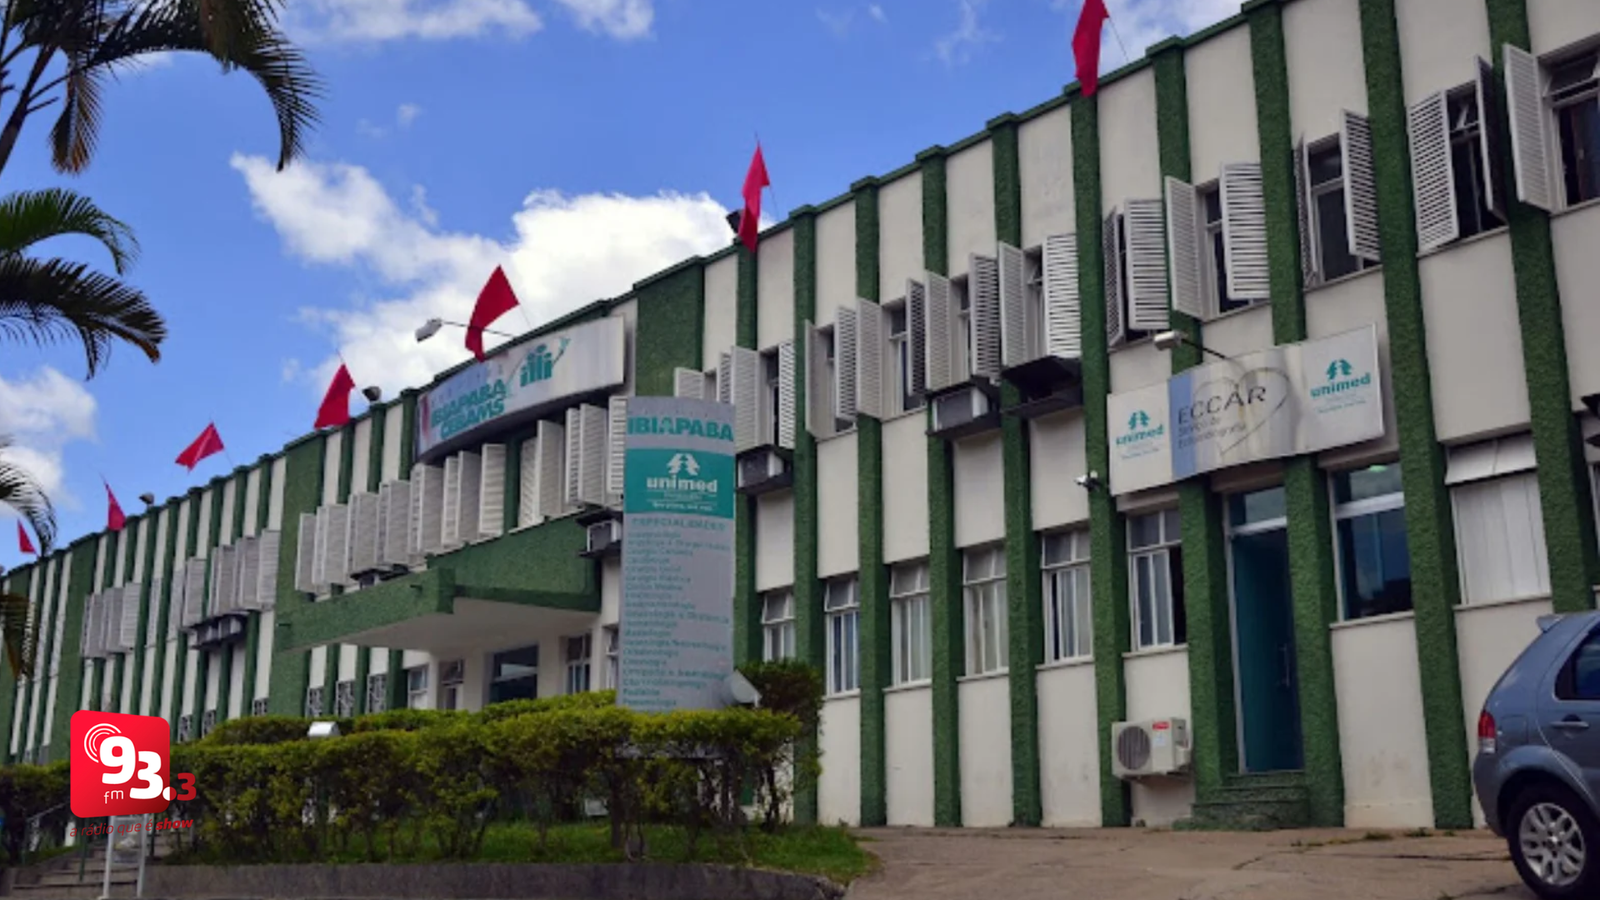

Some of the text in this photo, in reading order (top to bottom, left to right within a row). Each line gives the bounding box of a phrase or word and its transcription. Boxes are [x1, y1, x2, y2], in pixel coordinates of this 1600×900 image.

[1310, 372, 1371, 399] unimed
[627, 415, 734, 442] IBIAPABA
[1115, 423, 1164, 446] unimed
[646, 474, 718, 493] unimed
